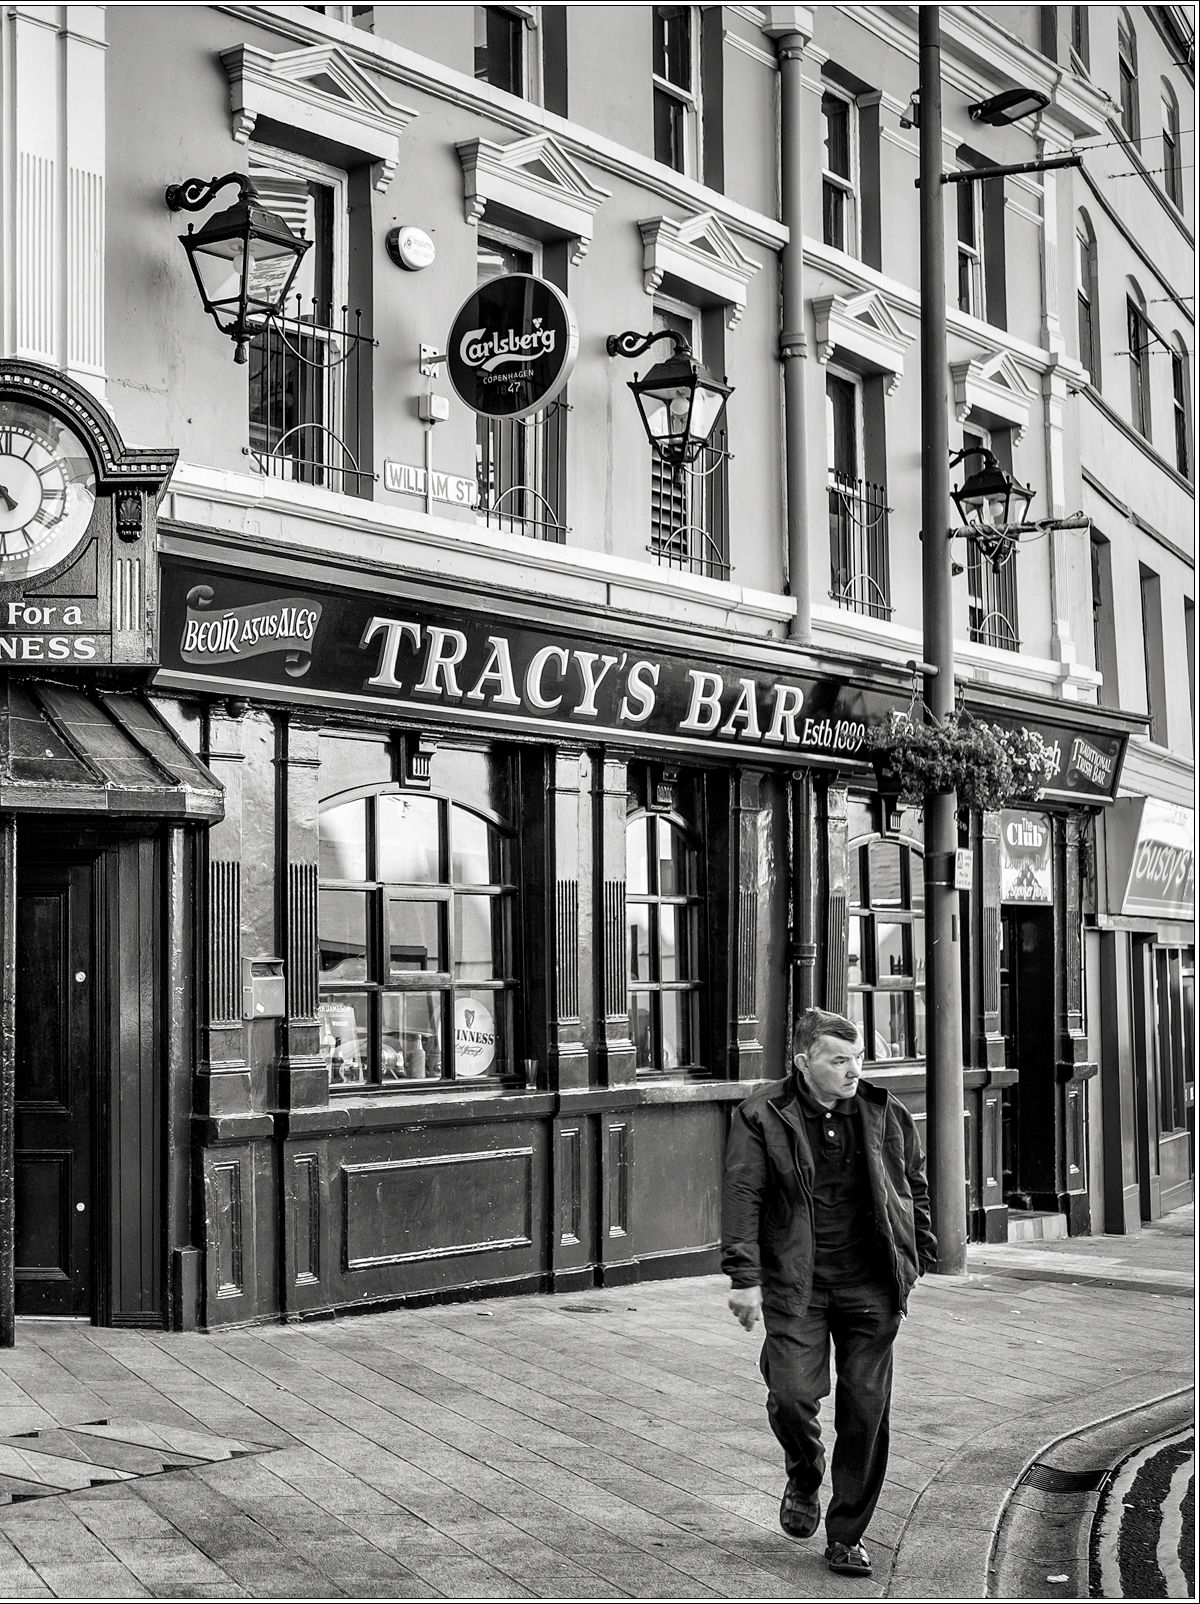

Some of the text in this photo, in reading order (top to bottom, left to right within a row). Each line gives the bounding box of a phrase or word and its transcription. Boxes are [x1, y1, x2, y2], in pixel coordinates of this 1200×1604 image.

[460, 327, 556, 366] Carlsberg
[482, 368, 535, 385] COPENHAGEN
[456, 480, 474, 503] ST
[8, 602, 57, 625] For
[63, 605, 83, 625] a
[276, 607, 317, 640] ALES
[363, 616, 661, 722] TRACY'S
[680, 669, 805, 744] BAR
[1072, 738, 1112, 773] TRADITIONAL
[1075, 753, 1094, 777] IRISH
[1091, 765, 1106, 785] BAR
[1006, 822, 1043, 847] Club
[1021, 817, 1033, 832] The
[455, 1029, 495, 1046] INNESS
